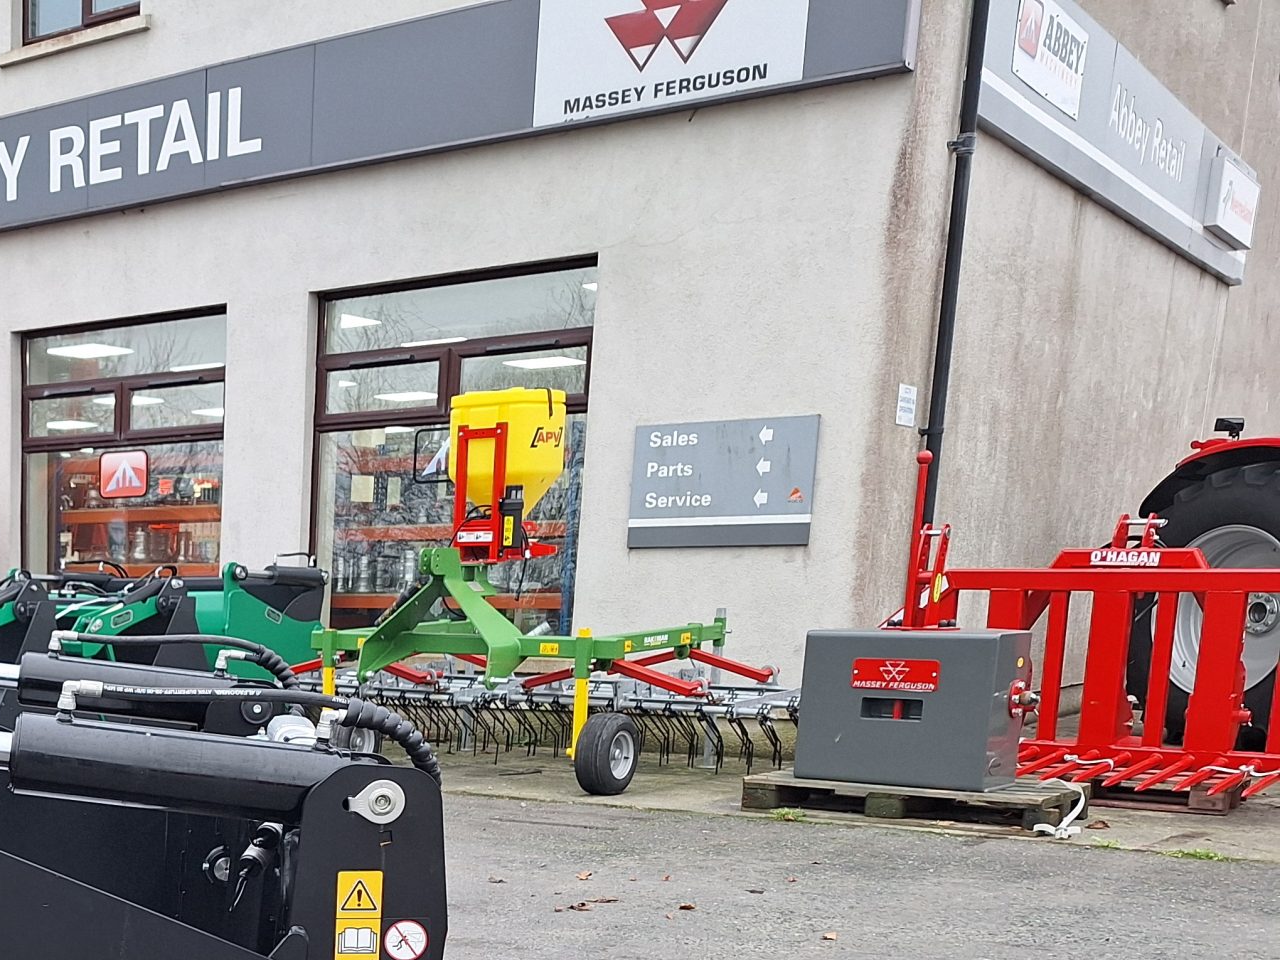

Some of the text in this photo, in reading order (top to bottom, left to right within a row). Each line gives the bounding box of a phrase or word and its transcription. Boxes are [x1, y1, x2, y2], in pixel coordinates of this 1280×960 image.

[1043, 14, 1085, 74] ABBEY
[563, 63, 769, 115] MASSEY FERGUSON
[48, 86, 263, 194] RETAIL
[1108, 83, 1187, 184] Abbey Retail
[649, 430, 699, 448] Sales
[646, 462, 693, 478] Parts
[645, 490, 712, 509] Service
[1090, 550, 1161, 562] O'HAGAN
[852, 680, 935, 690] MASSEY FERGUSON
